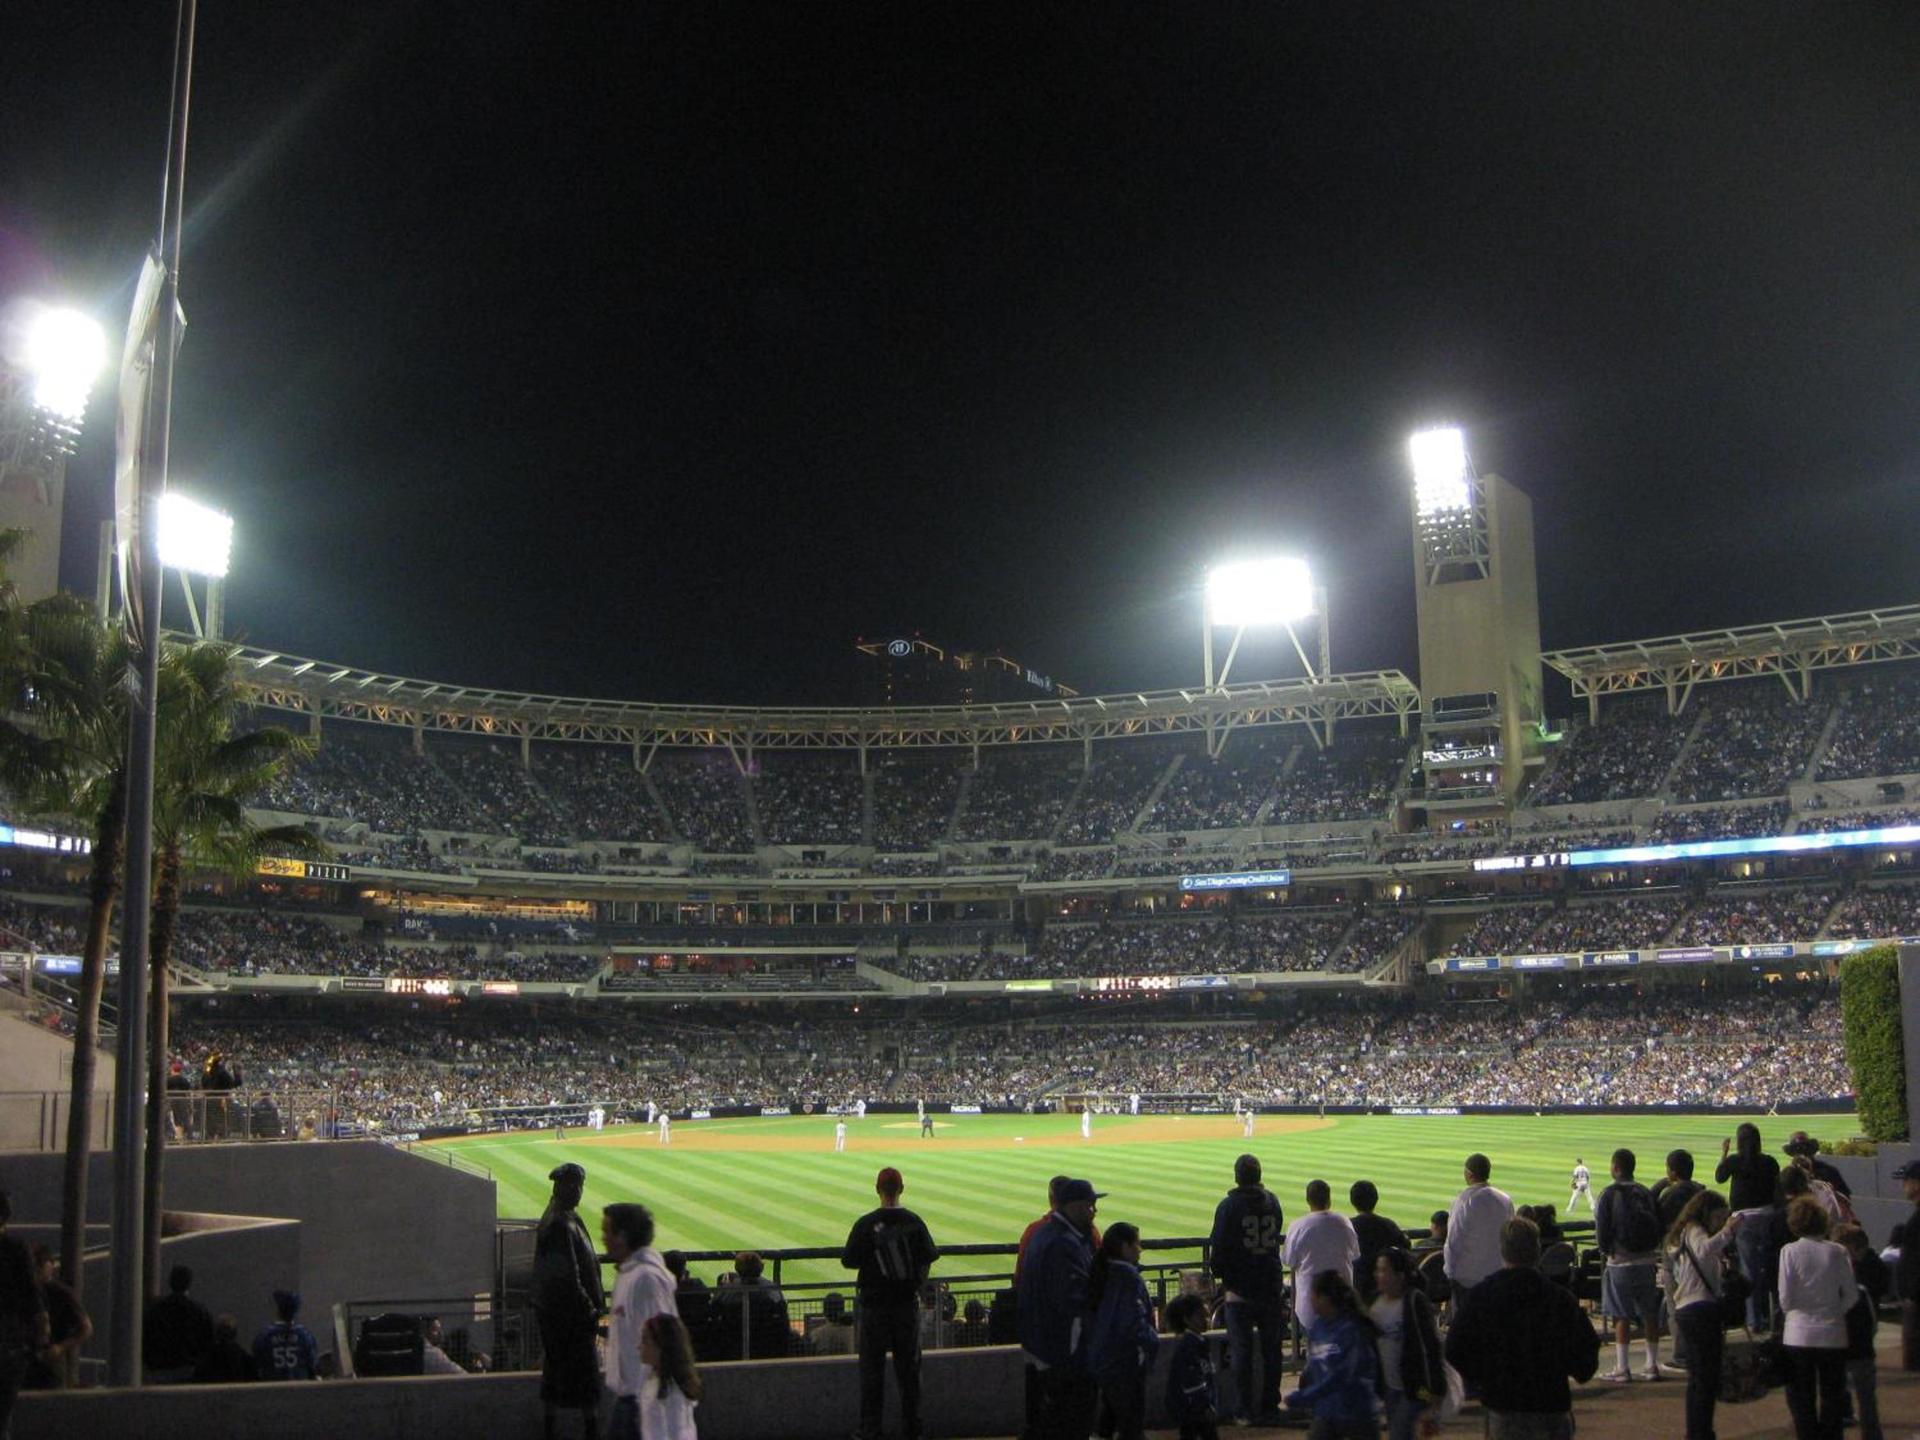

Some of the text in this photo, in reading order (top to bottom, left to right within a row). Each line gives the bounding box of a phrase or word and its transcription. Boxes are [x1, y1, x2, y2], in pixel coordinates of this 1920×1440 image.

[309, 865, 346, 879] PIZZA
[761, 1106, 791, 1116] NOKIA
[951, 1105, 982, 1113] NOKIA
[1392, 1107, 1458, 1115] NOKIA NOKIA
[1241, 1215, 1277, 1248] 32
[272, 1346, 298, 1369] 55
